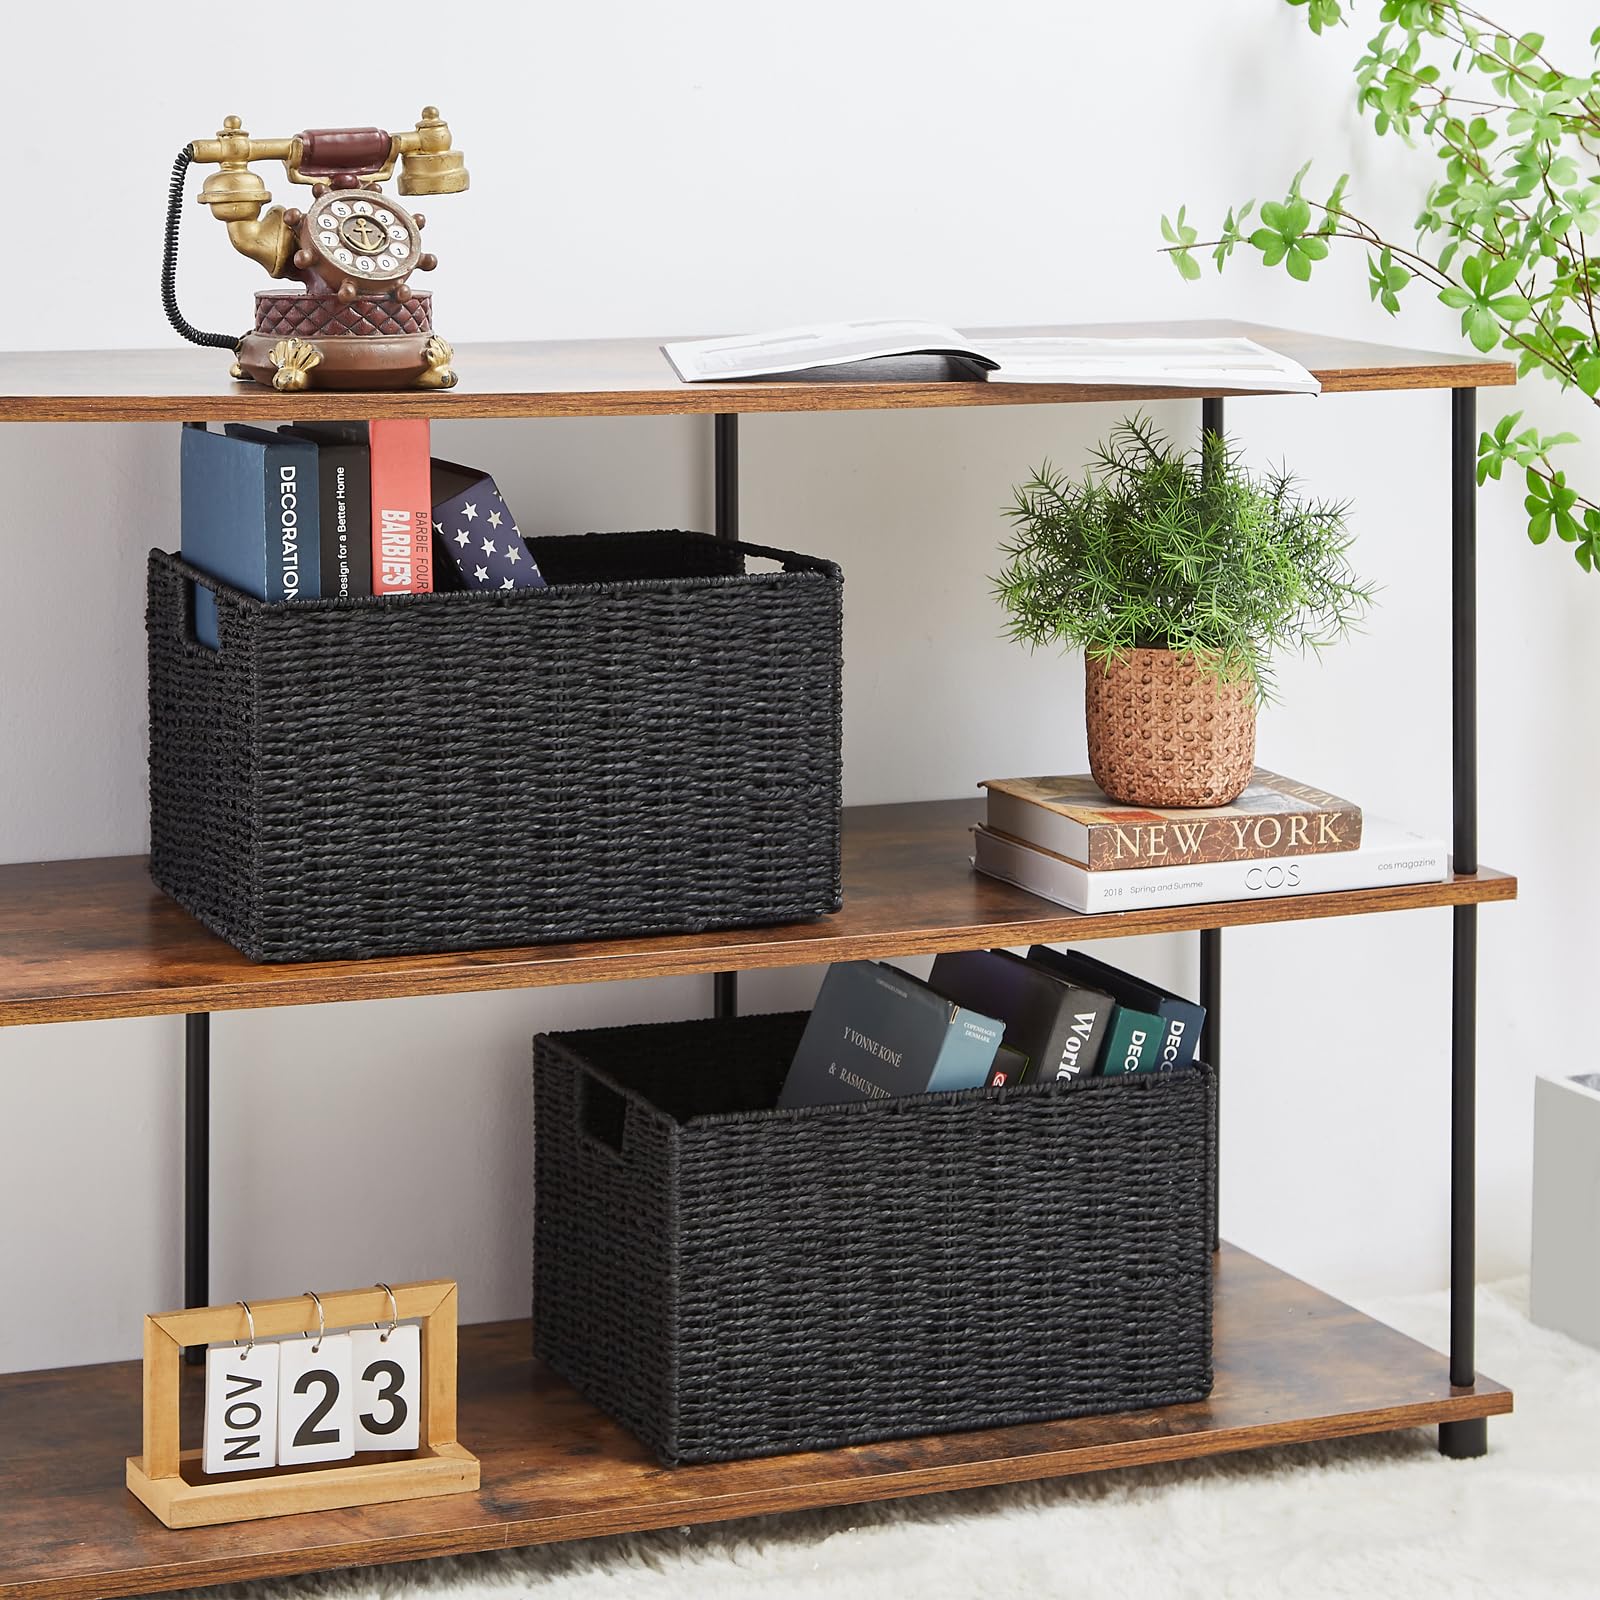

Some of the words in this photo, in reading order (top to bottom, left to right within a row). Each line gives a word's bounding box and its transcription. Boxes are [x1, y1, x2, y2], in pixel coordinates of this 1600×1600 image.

[335, 466, 346, 499] Home
[280, 465, 299, 600] DECORATION
[336, 501, 347, 533] Better
[415, 511, 428, 553] BARBIE
[337, 543, 348, 560] for
[339, 534, 347, 542] a
[338, 561, 350, 598] Design
[416, 557, 429, 590] FOUR
[1113, 822, 1210, 860] NEW
[1229, 812, 1343, 851] YORK
[1244, 864, 1302, 891] COS
[1377, 862, 1394, 871] cos
[1393, 858, 1436, 870] magazine
[1103, 887, 1124, 898] 2018
[1129, 884, 1156, 896] Spring
[1156, 882, 1173, 893] and
[963, 1021, 997, 1038] COPENHAGEN
[877, 1042, 904, 1069] KONÉ
[827, 1061, 837, 1076] &
[838, 1066, 873, 1095] RASMUS
[223, 1373, 263, 1462] NOV
